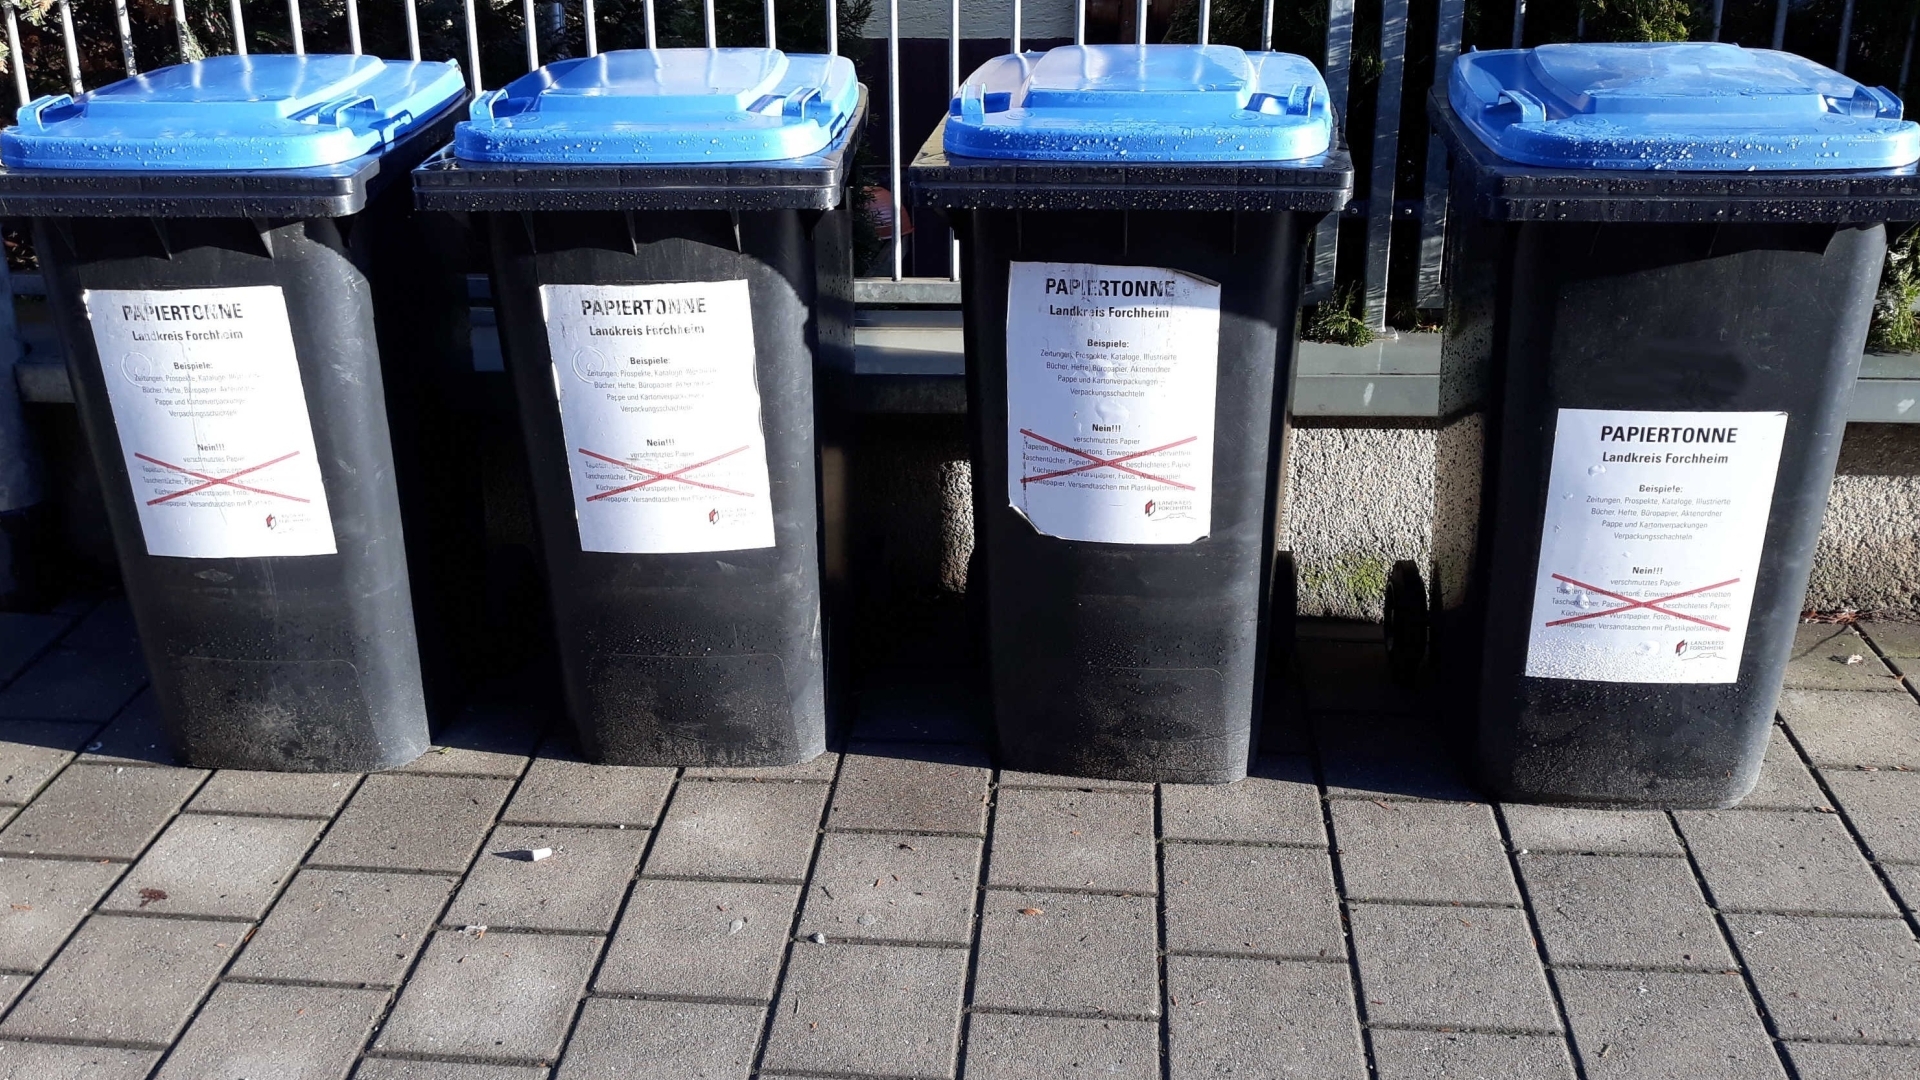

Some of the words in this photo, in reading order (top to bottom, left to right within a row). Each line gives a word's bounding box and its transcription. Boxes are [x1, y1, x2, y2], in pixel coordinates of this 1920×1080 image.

[1045, 278, 1176, 297] PAPIERTONNE
[122, 303, 243, 321] PAPIERTONNE
[581, 298, 706, 316] PAPIERTONNE
[1049, 305, 1105, 317] Landkreis
[1108, 306, 1170, 318] Forchheim
[589, 325, 643, 336] Landkreis
[645, 324, 705, 335] Forchheim
[132, 330, 183, 341] Landkreis
[1087, 339, 1130, 349] Beispiele:
[1040, 349, 1073, 359] Zeitungen,
[1075, 351, 1109, 360] Prospekte,
[1110, 353, 1142, 361] Kataloge,
[173, 362, 213, 371] Beispiele:
[630, 357, 671, 366] Beispiele:
[1046, 361, 1070, 370] Bücher,
[1130, 365, 1171, 373] Aktenordner
[1057, 374, 1078, 383] Pappe
[1070, 387, 1145, 397] Verpackungsschachteln
[1092, 423, 1121, 432] Nein!!!
[1600, 426, 1738, 443] PAPIERTONNE
[646, 438, 675, 447] Nein!!!
[1073, 436, 1118, 445] verschmutztes
[1119, 437, 1140, 446] Papier
[197, 443, 225, 451] Nein!!!
[1602, 452, 1662, 463] Landkreis
[1665, 453, 1728, 464] Forchheim
[1068, 481, 1118, 490] Versandtaschen
[1639, 484, 1684, 494] Beispiele:
[1586, 495, 1623, 505] Zeitungen,
[1624, 497, 1660, 506] Prospekte,
[1661, 498, 1694, 506] Kataloge,
[1591, 508, 1616, 516] Bücher,
[1617, 509, 1639, 517] Hefte,
[1640, 509, 1679, 517] Büropapier,
[1601, 520, 1623, 528] Pappe
[1639, 521, 1708, 530] Kartonverpackungen
[1614, 532, 1693, 541] Verpackungsschachteln
[1632, 566, 1664, 575] Nein!!!
[1659, 579, 1682, 587] Papier
[1598, 623, 1650, 631] Versandtaschen
